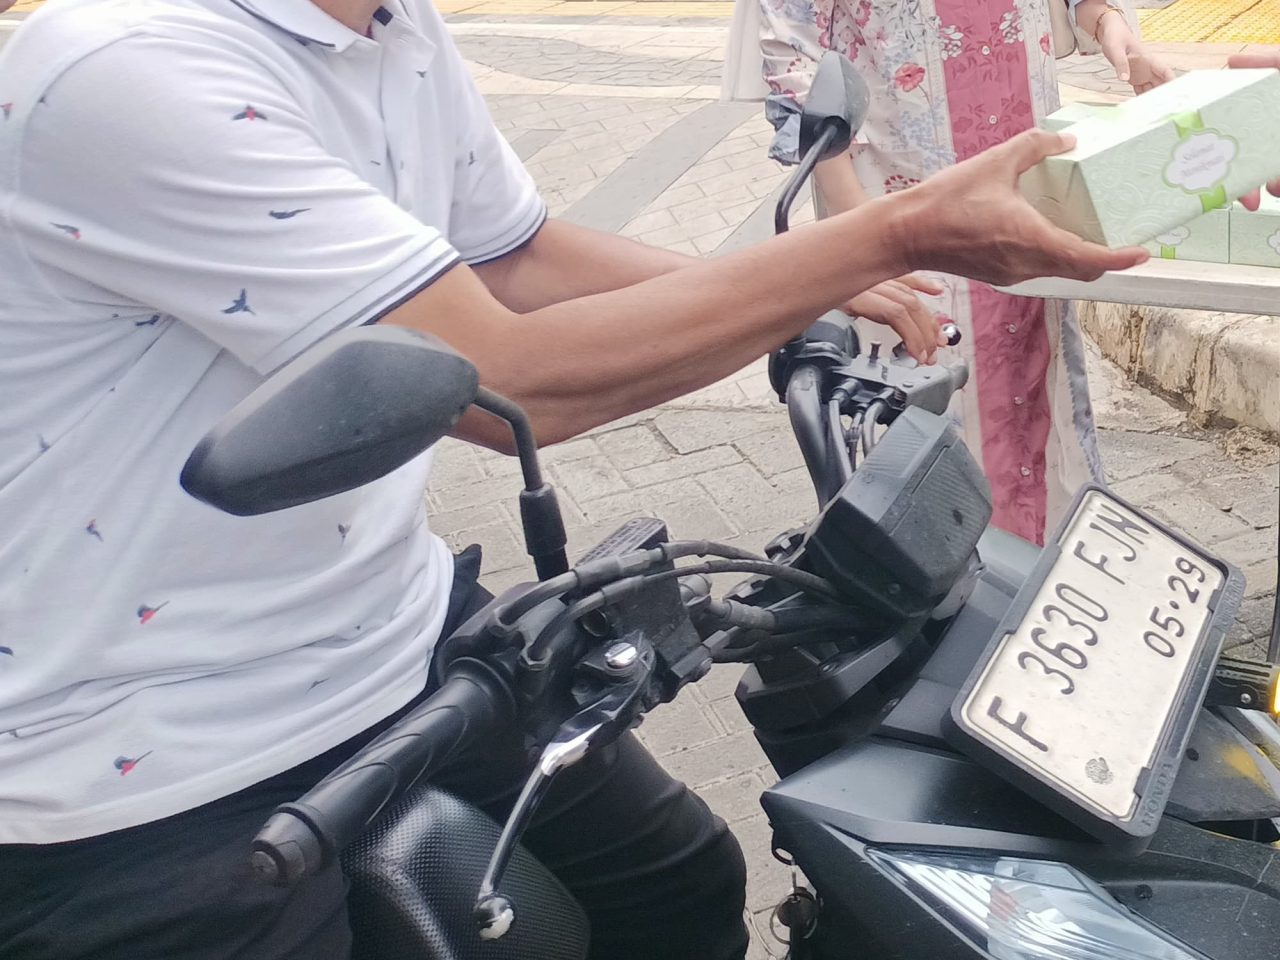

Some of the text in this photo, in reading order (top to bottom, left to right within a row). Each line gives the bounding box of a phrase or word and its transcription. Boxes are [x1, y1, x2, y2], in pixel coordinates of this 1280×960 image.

[986, 503, 1151, 753] F 3630 FJN
[1139, 760, 1174, 827] HONDA
